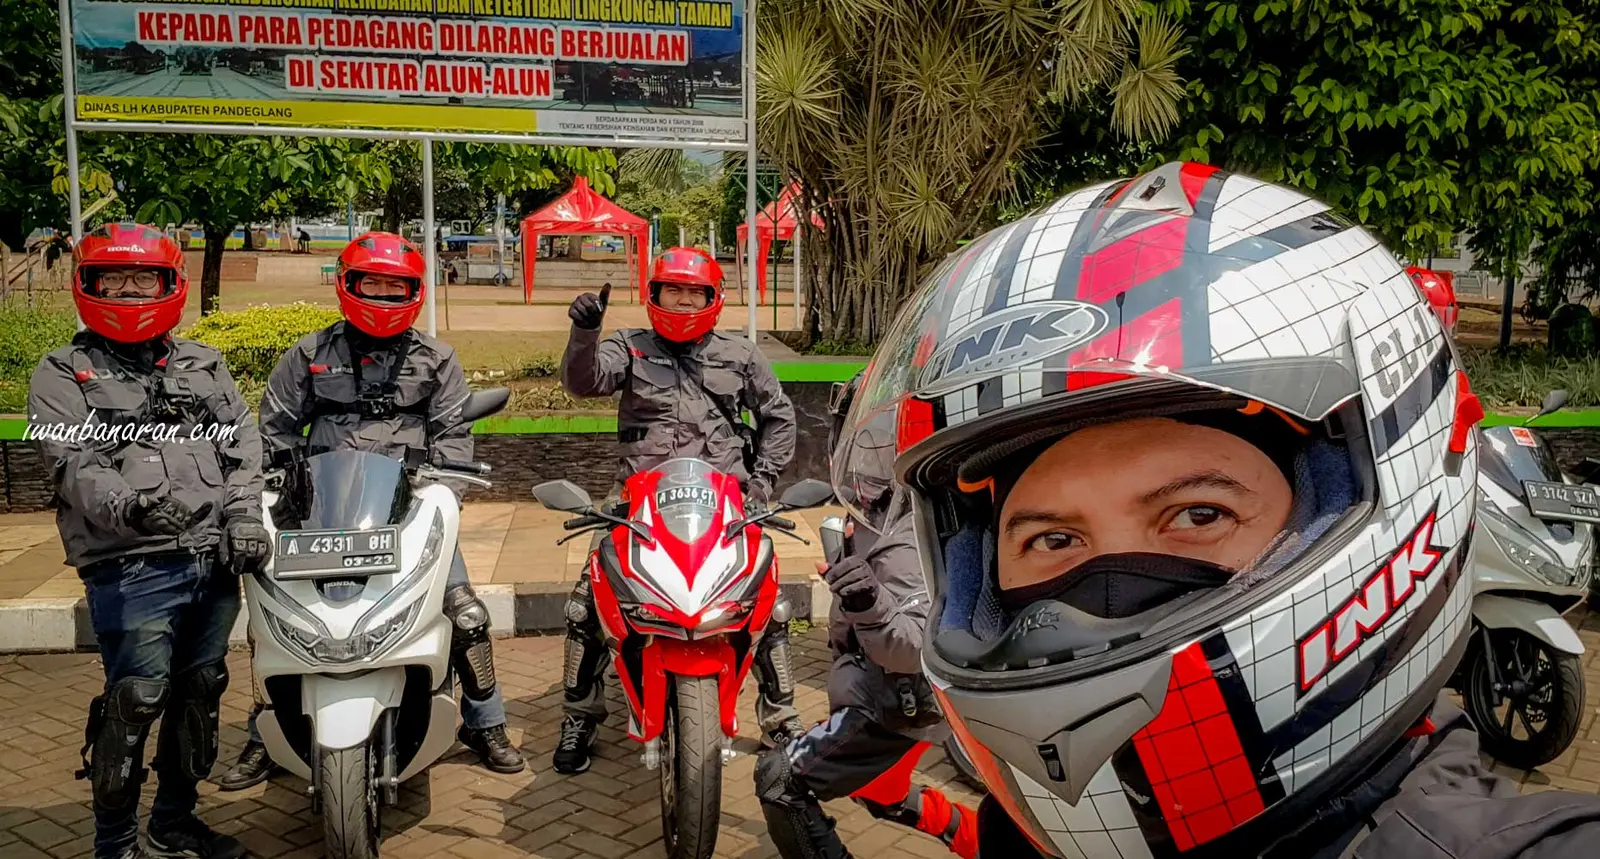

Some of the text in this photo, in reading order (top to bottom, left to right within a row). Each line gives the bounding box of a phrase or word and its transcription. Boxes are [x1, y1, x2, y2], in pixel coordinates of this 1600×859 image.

[574, 0, 676, 25] LINGKUNGAN
[679, 2, 732, 27] TAMAN
[138, 12, 685, 62] KEPADA PARA PEDAGANG DILARANG BERJUALAN
[289, 59, 550, 97] DI SEKITAR ALUN-ALUN
[84, 103, 293, 118] DINAS LH KABUPATEN PANDEGLANG
[107, 244, 145, 253] HONDA
[659, 492, 667, 504] A
[670, 487, 698, 500] 3636
[1529, 484, 1537, 498] B
[1542, 486, 1571, 502] 3742
[287, 534, 392, 556] A 4331 BH
[343, 554, 393, 567] 03-23
[323, 580, 357, 588] HONDA
[1299, 507, 1445, 693] INK
